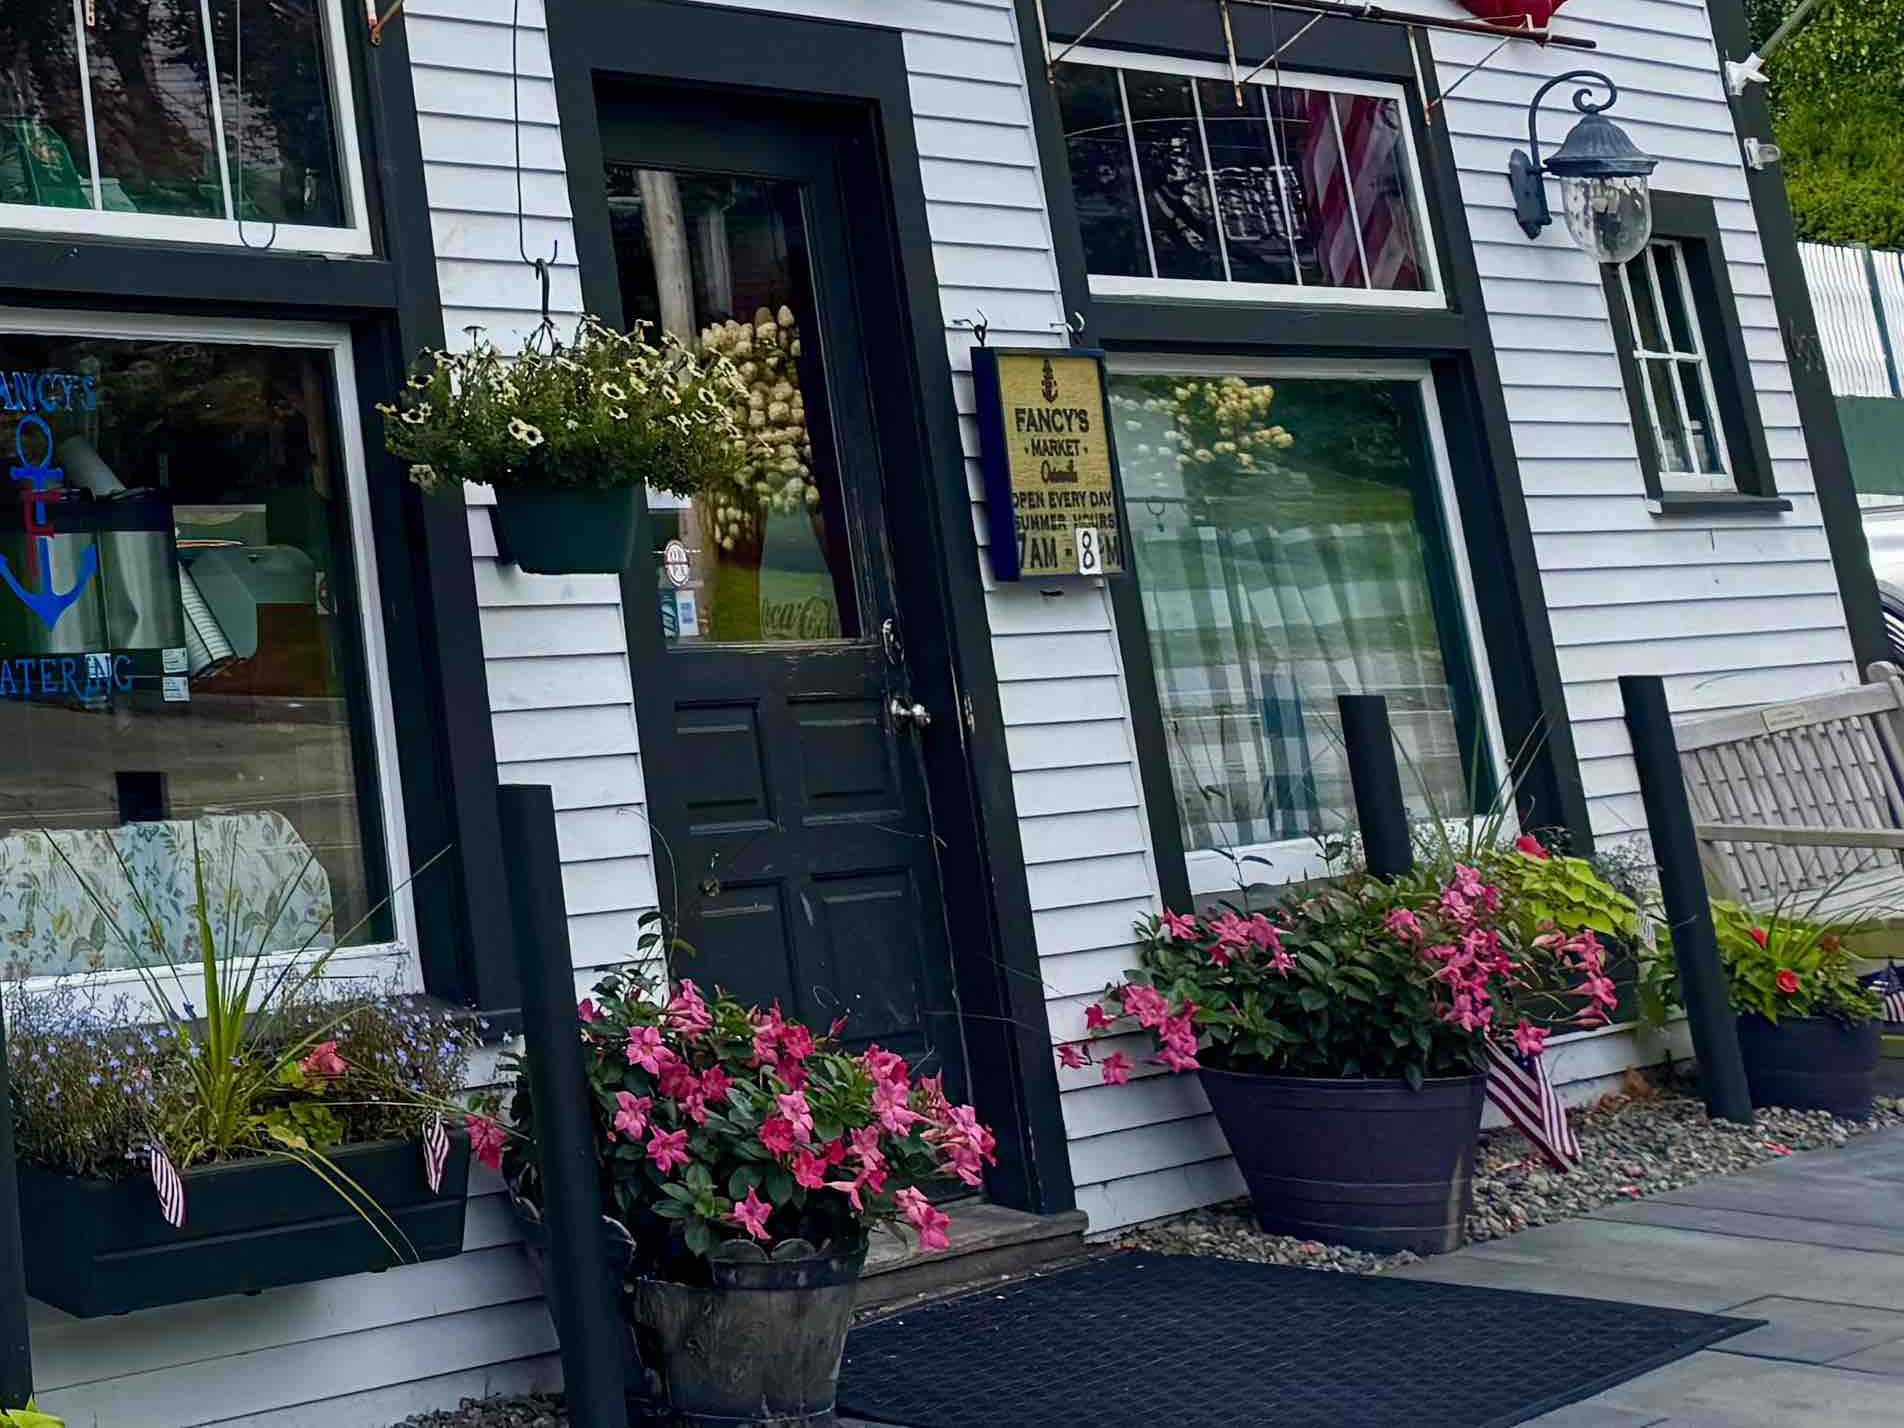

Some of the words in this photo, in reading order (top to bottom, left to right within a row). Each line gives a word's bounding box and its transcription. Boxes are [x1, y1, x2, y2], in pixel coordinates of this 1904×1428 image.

[1014, 407, 1090, 434] FANCY'S
[1031, 438, 1081, 457] MARKET
[1049, 491, 1087, 510] EVERY
[1091, 491, 1112, 508] DAY
[1030, 536, 1059, 569] AM
[1081, 529, 1096, 571] 8
